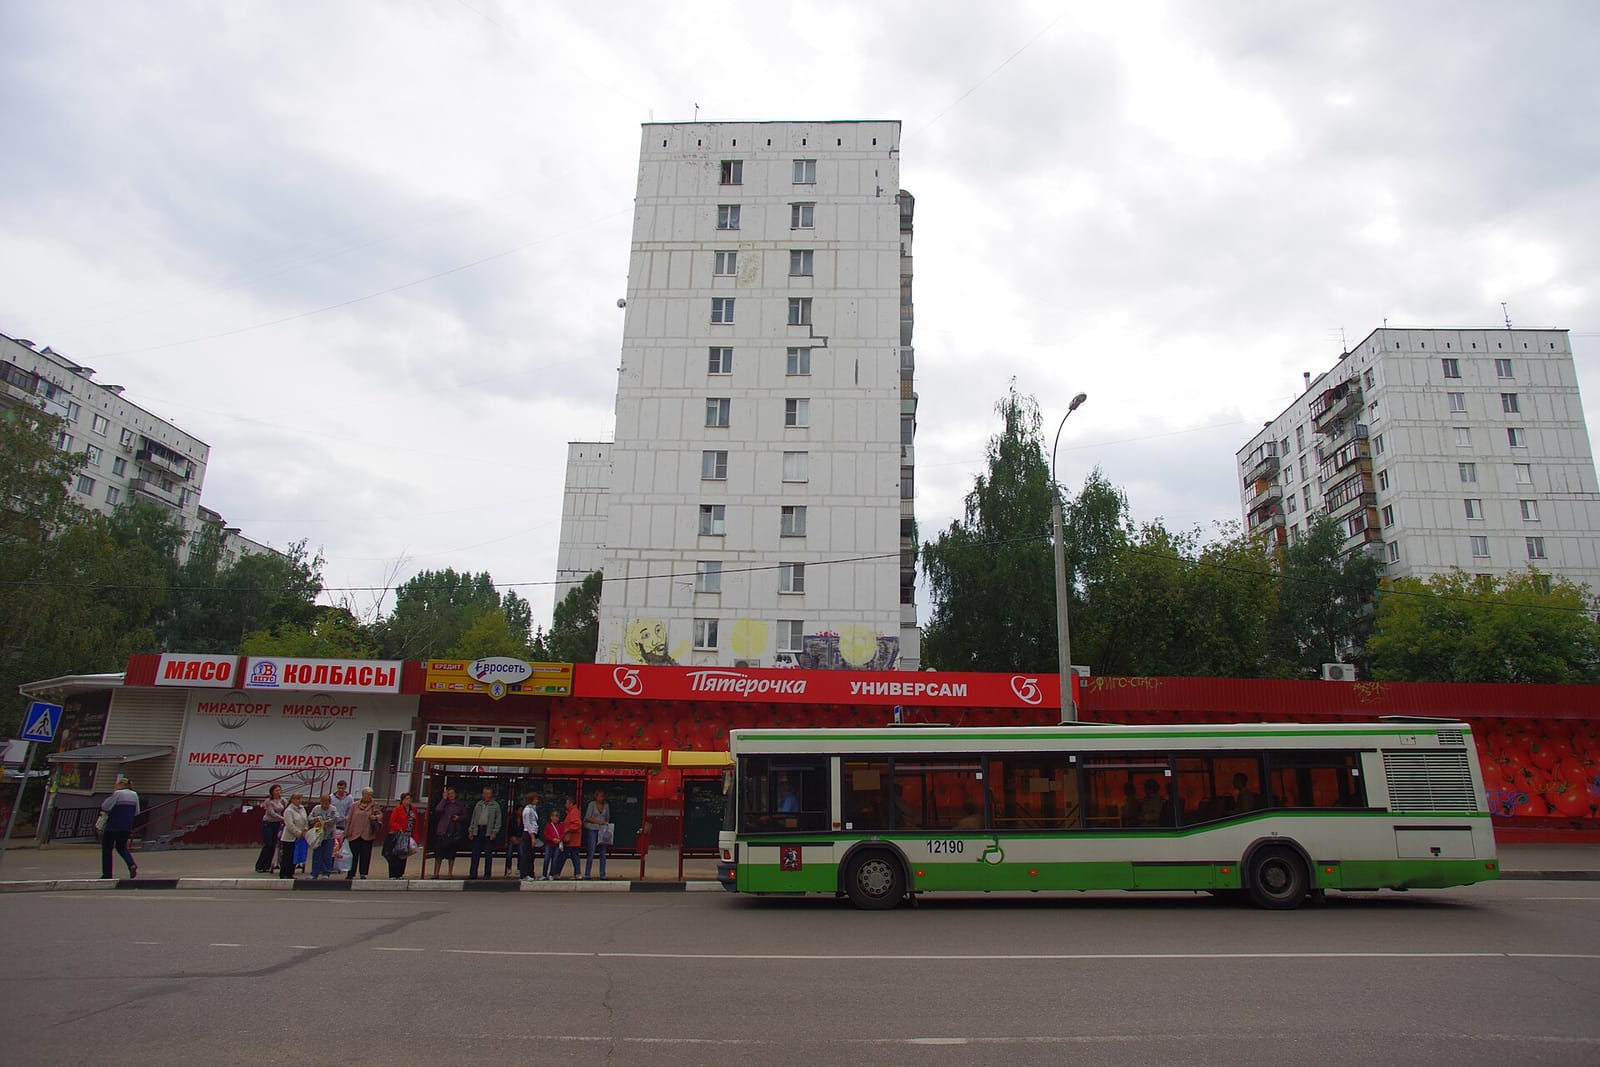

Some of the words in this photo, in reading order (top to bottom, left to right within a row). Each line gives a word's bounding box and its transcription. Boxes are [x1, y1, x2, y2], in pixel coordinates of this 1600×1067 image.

[164, 661, 231, 681] МЯСО
[475, 660, 526, 675] Евросеть
[283, 664, 396, 687] КОЛБАСЫ
[686, 671, 807, 697] Пятёрочка
[850, 681, 968, 697] УНИВЕРСАМ
[197, 702, 272, 715] МИРАТОРГ
[282, 704, 358, 717] МИРАТОРГ
[188, 752, 264, 765] МИРАТОРГ
[275, 754, 352, 768] МИРАТОРГ
[926, 840, 964, 854] 12190
